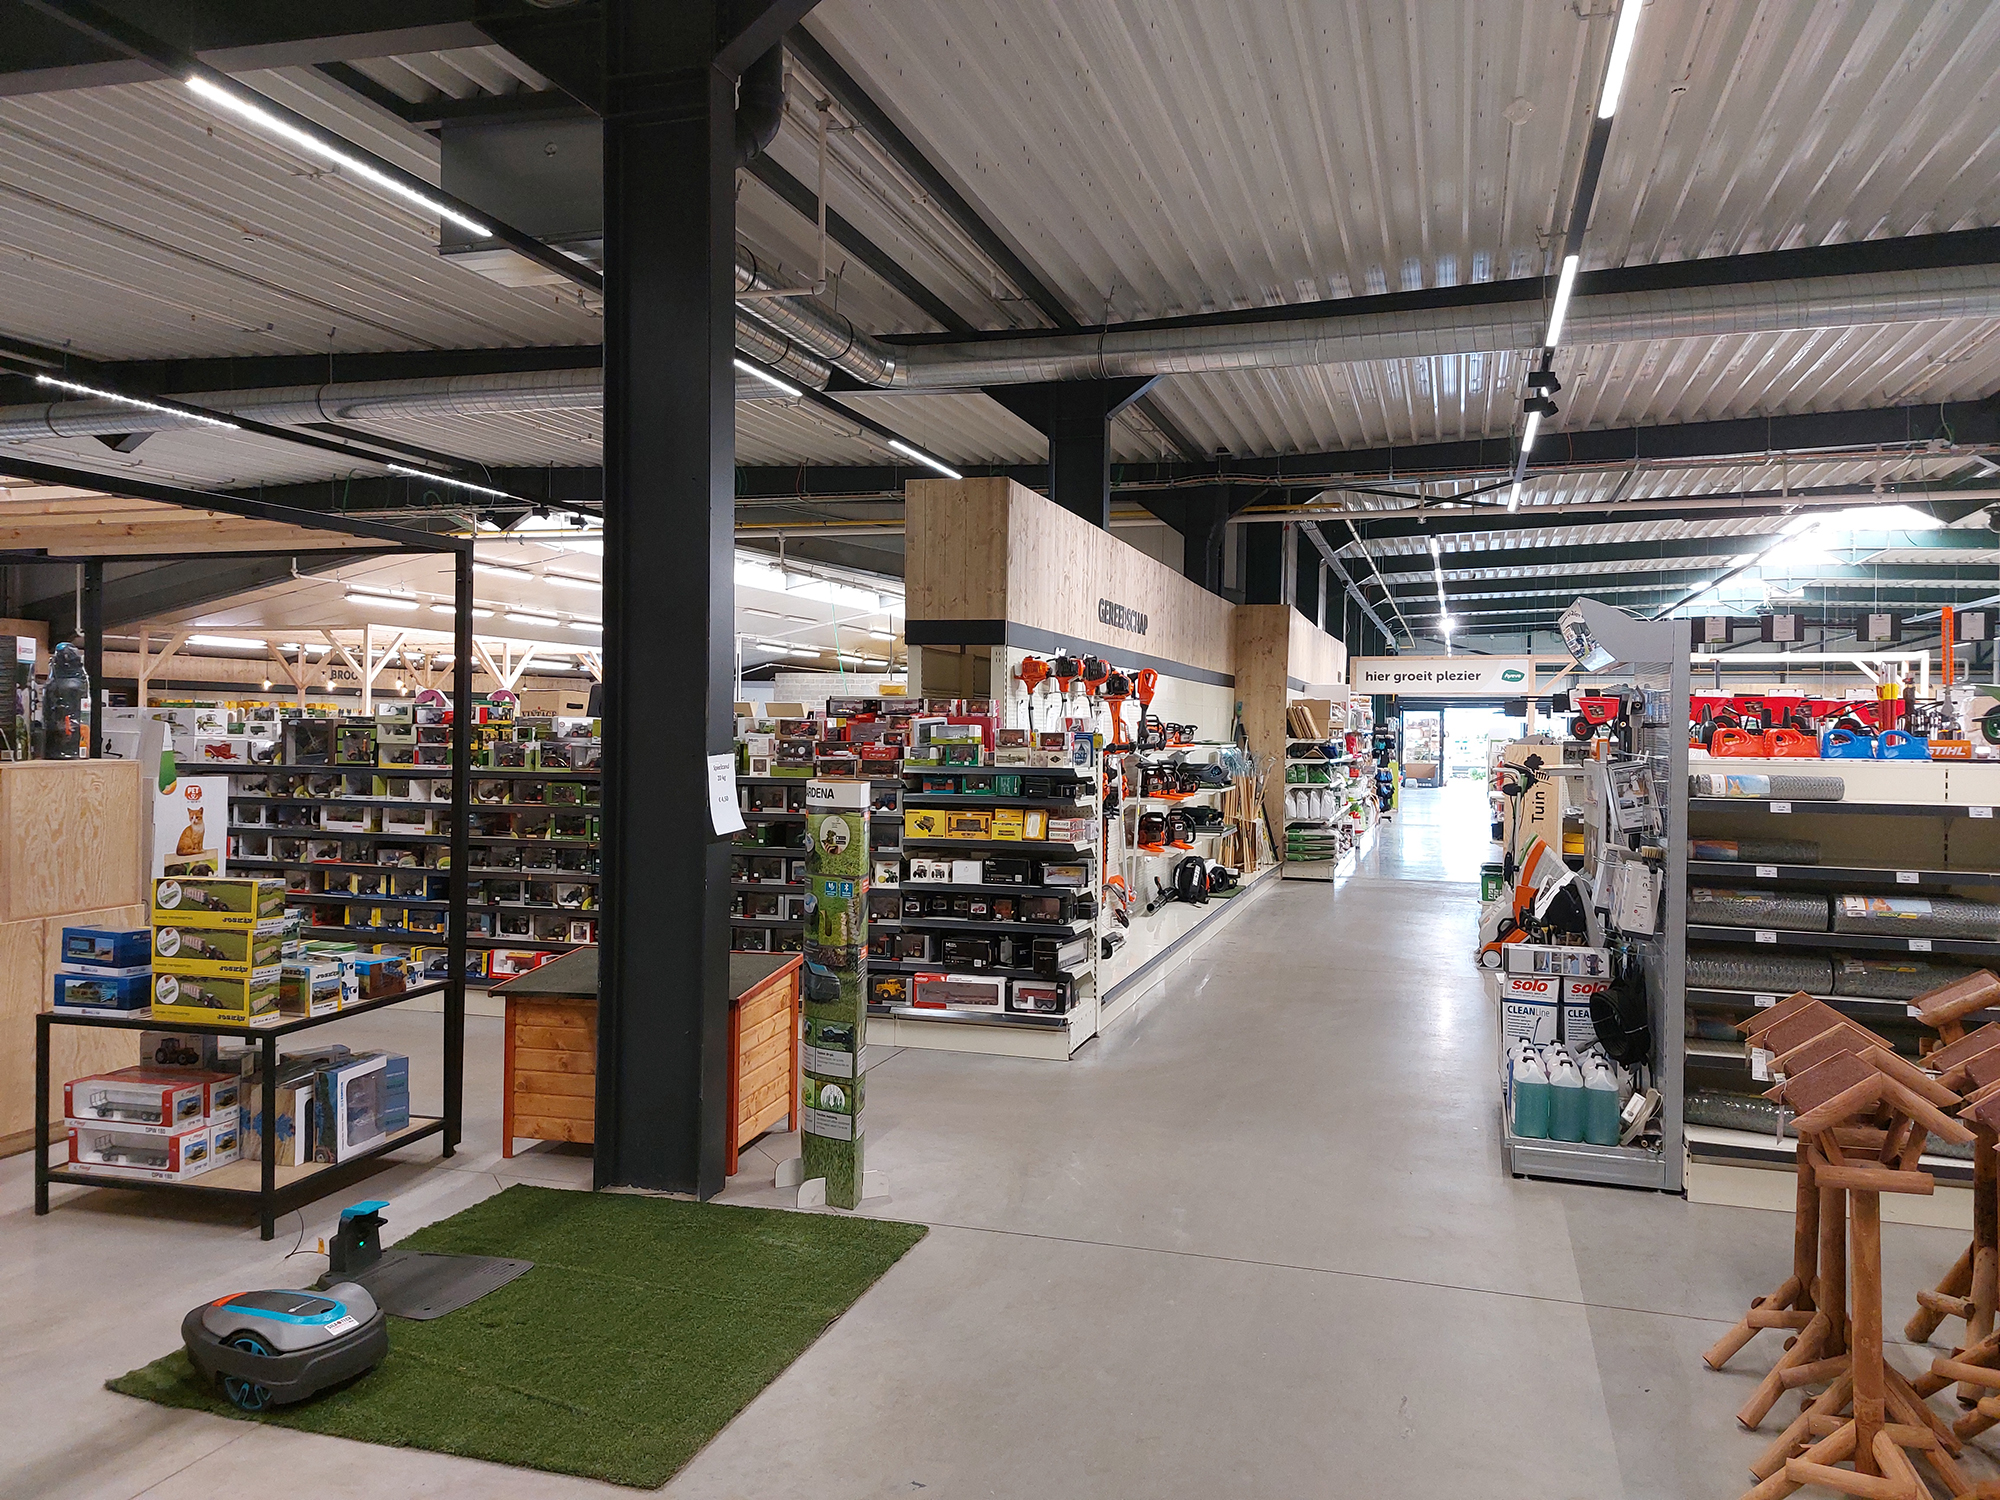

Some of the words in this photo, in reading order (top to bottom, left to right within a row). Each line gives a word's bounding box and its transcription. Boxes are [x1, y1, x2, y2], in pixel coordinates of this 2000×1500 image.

[1365, 671, 1390, 681] hier
[1393, 671, 1432, 683] groeit
[1436, 671, 1481, 683] plezier
[1531, 791, 1545, 823] Tuin
[1511, 979, 1548, 992] solo
[1571, 982, 1607, 994] solo
